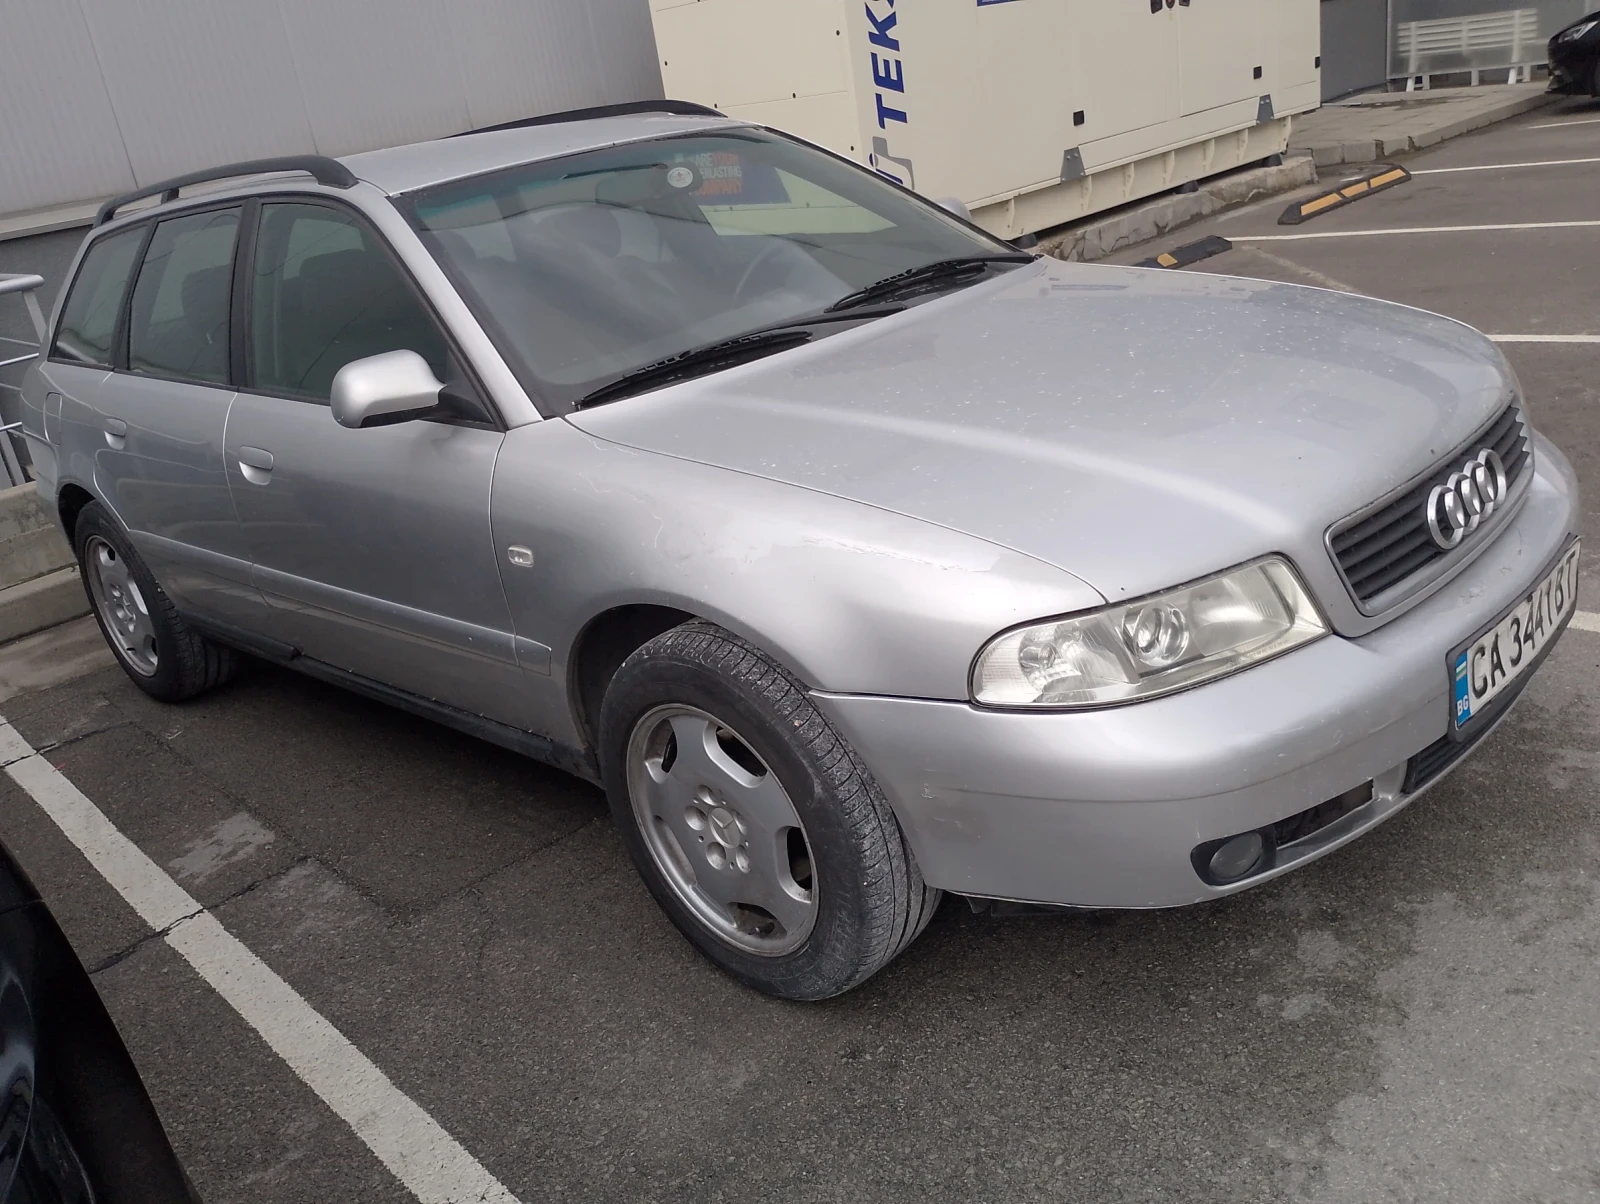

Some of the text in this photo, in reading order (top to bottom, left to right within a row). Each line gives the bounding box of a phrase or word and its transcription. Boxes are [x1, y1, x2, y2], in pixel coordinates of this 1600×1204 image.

[865, 0, 908, 129] TEK
[1471, 632, 1506, 700] CA
[1456, 695, 1469, 716] BG
